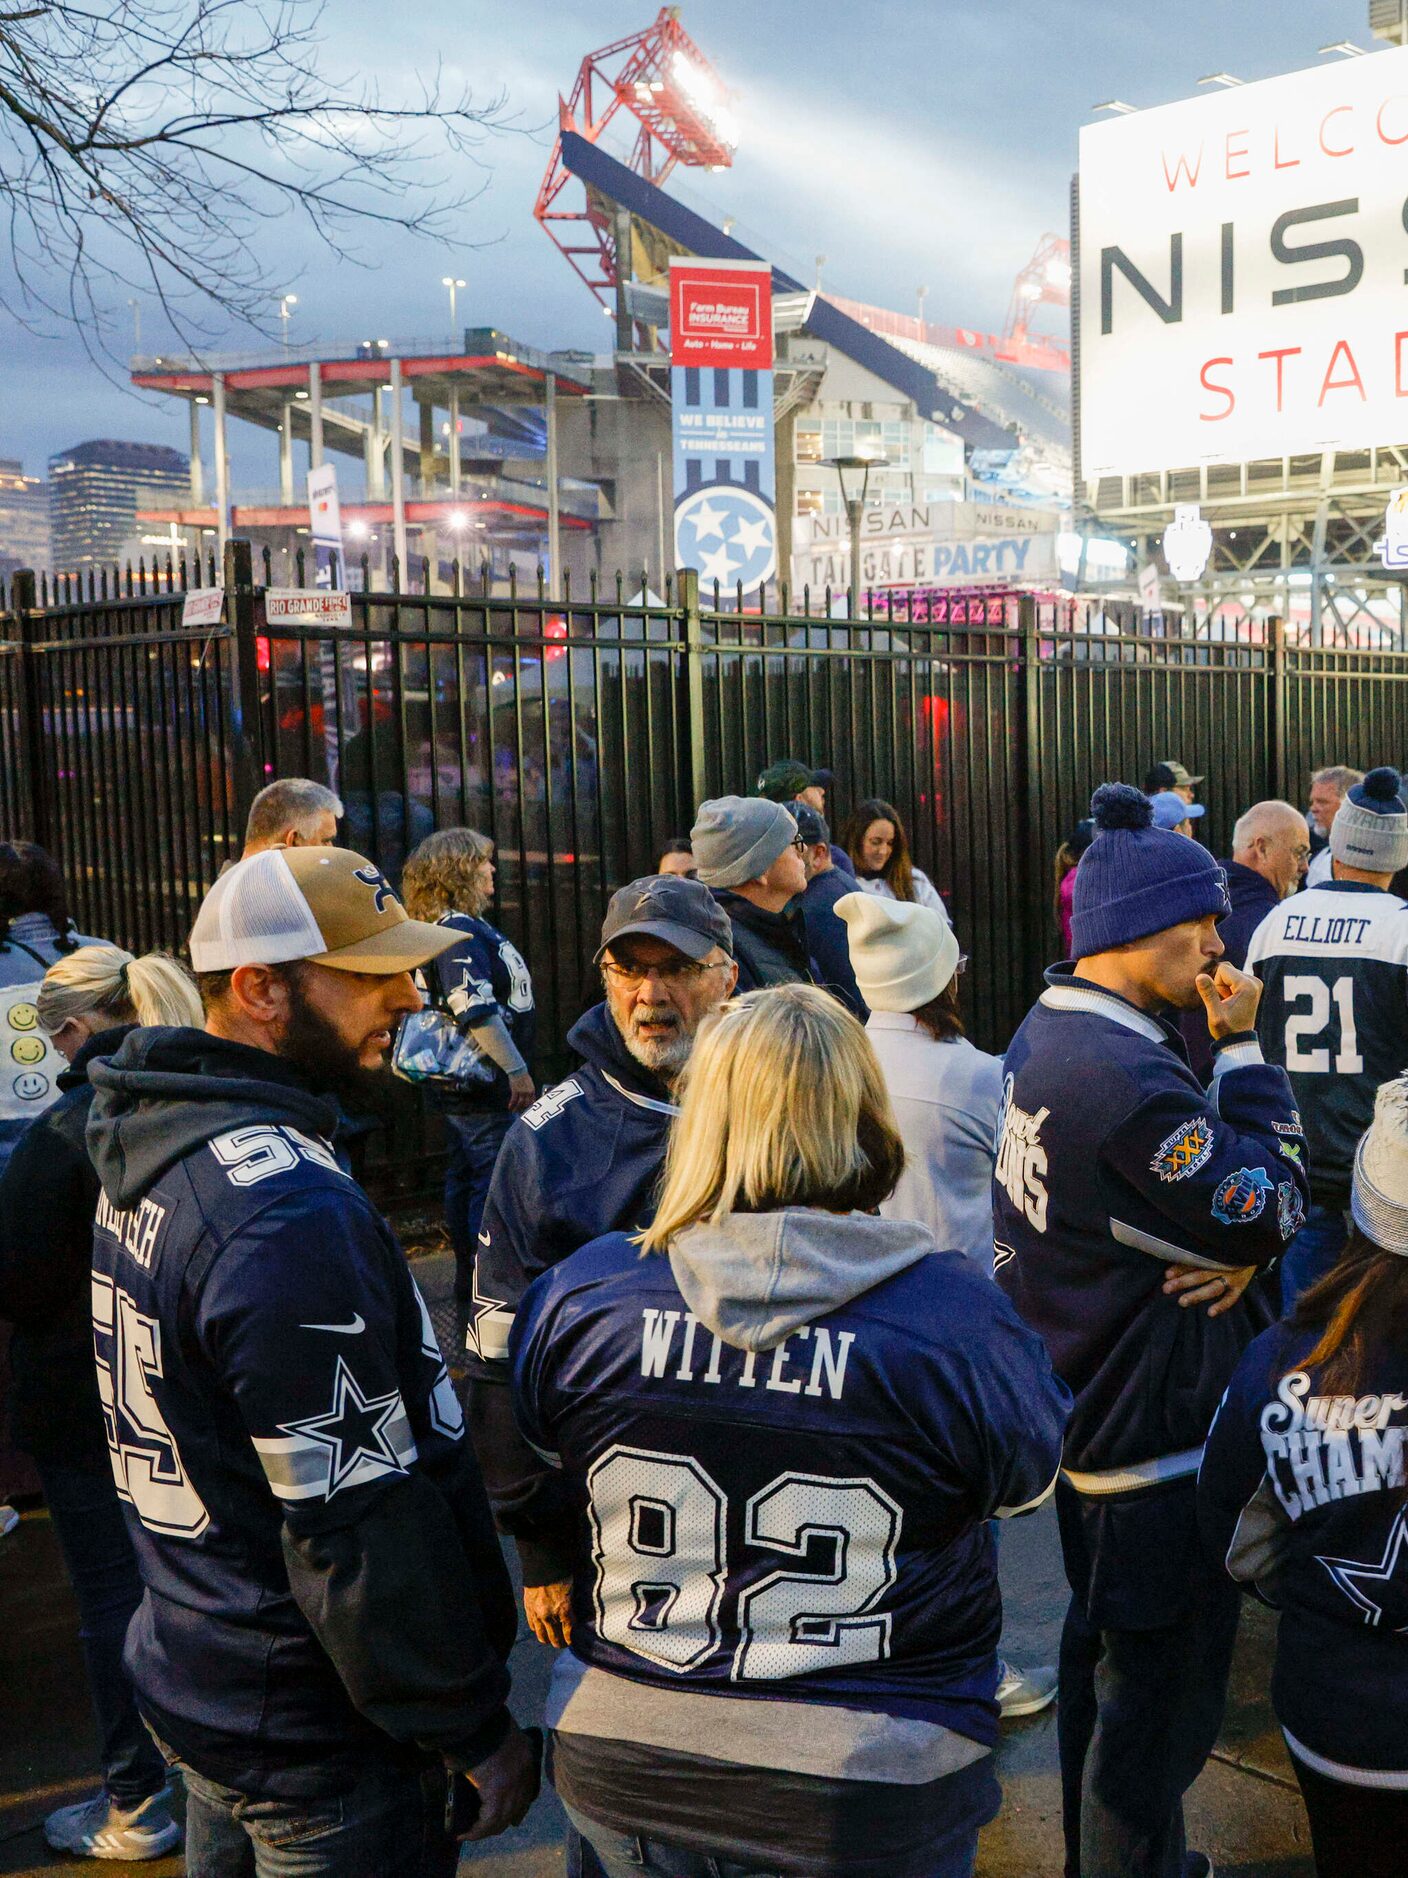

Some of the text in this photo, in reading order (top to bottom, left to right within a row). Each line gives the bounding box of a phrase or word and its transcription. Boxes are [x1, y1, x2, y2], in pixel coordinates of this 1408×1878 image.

[688, 313, 749, 324] INSURANCE
[690, 302, 749, 315] Farm Bureau
[683, 338, 757, 351] Auto Home Life
[680, 414, 765, 429] WE BELIEVE
[680, 439, 766, 453] TENNESSEANS
[976, 512, 1040, 531] NISSAN
[810, 538, 1031, 586] TAIGATE PARTY
[270, 600, 286, 615] RIO
[287, 598, 325, 614] GRANDE
[1283, 915, 1371, 945] ELLIOTT
[1283, 975, 1364, 1074] 21
[519, 1078, 586, 1131] 4
[1165, 1126, 1188, 1148] SUPER
[1187, 1151, 1209, 1173] BOWL
[585, 1442, 905, 1683] 82
